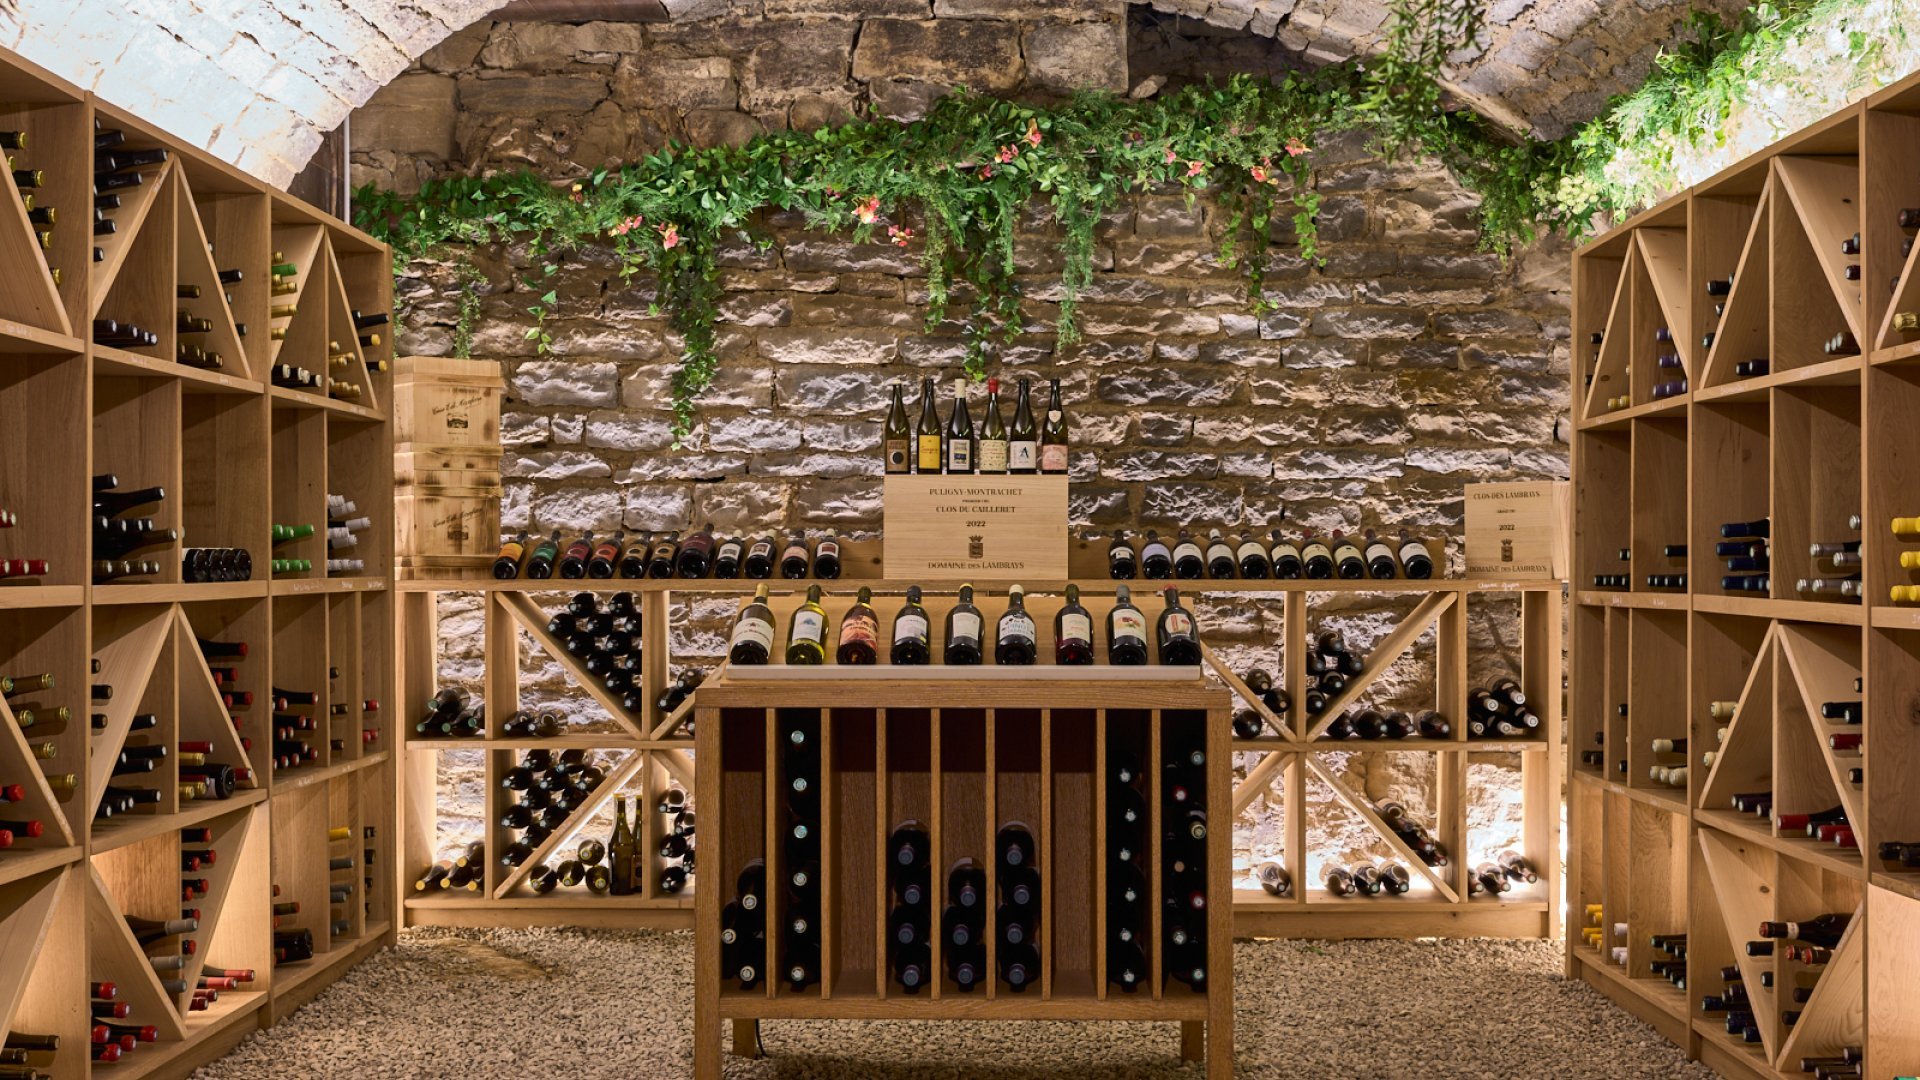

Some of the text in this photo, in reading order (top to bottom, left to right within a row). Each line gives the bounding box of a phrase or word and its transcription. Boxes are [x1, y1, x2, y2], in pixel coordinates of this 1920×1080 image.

[929, 488, 1023, 496] PULIGNY-MONTRACHET
[1473, 492, 1490, 500] CLOS
[1505, 491, 1541, 499] LAMBRAYS
[935, 505, 1017, 513] CLOS DU CAILLERET
[966, 520, 986, 528] 2022
[1469, 565, 1499, 573] DOMAINE
[1512, 565, 1547, 573] LAMBRAYS
